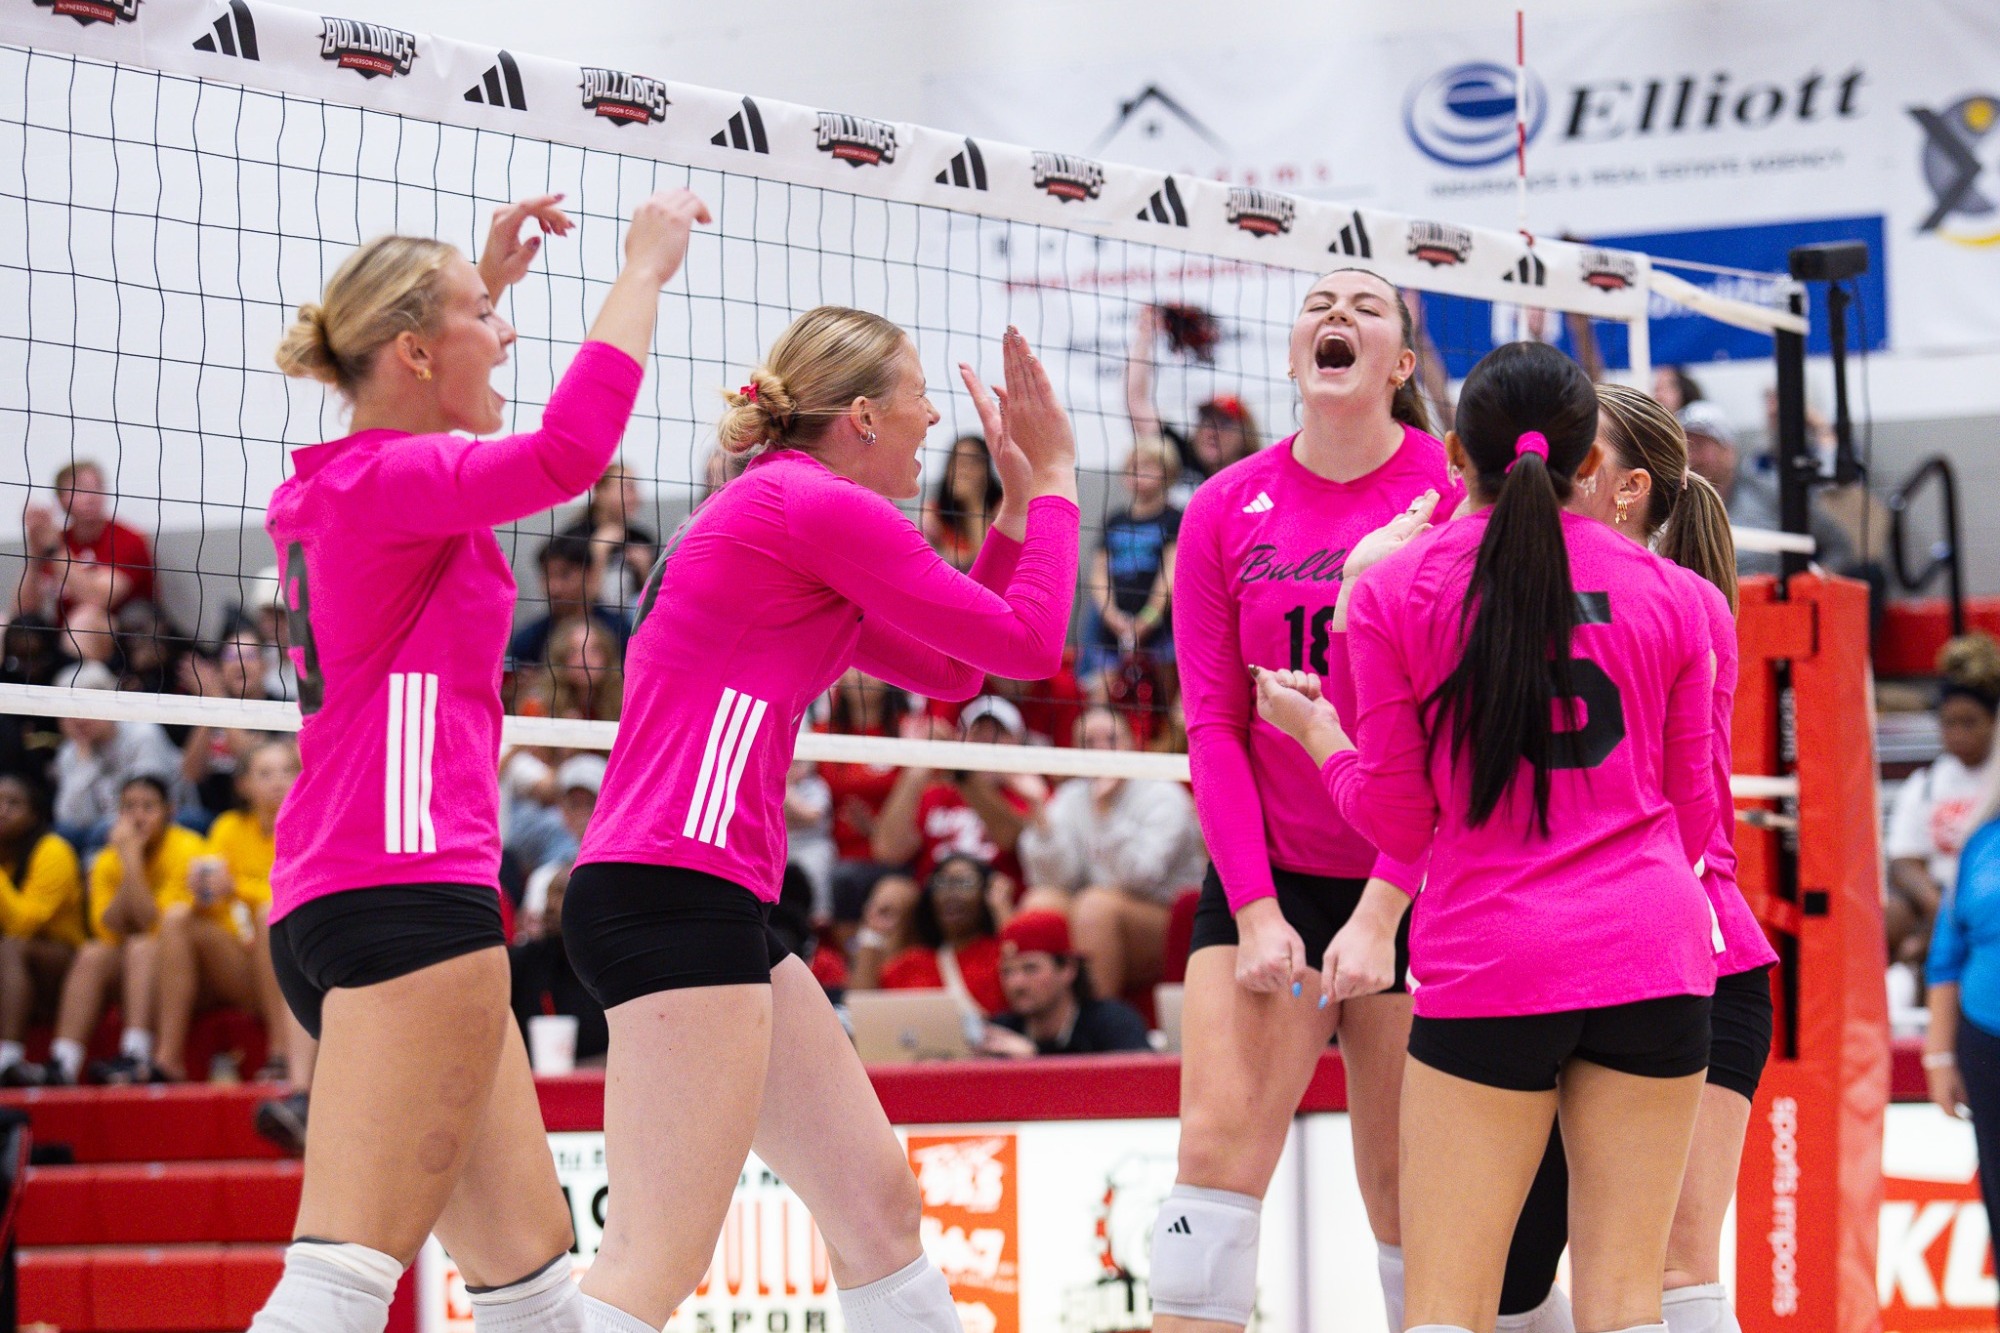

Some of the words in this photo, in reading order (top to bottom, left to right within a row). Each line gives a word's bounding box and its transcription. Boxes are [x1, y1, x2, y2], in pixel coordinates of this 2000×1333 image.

[321, 17, 415, 71] BULLDOGS
[582, 68, 666, 118] BULLDOGS
[1562, 67, 1867, 143] Elliott
[817, 112, 895, 159] BULLDOGS
[1520, 591, 1627, 770] 5
[696, 1201, 831, 1296] ULLD
